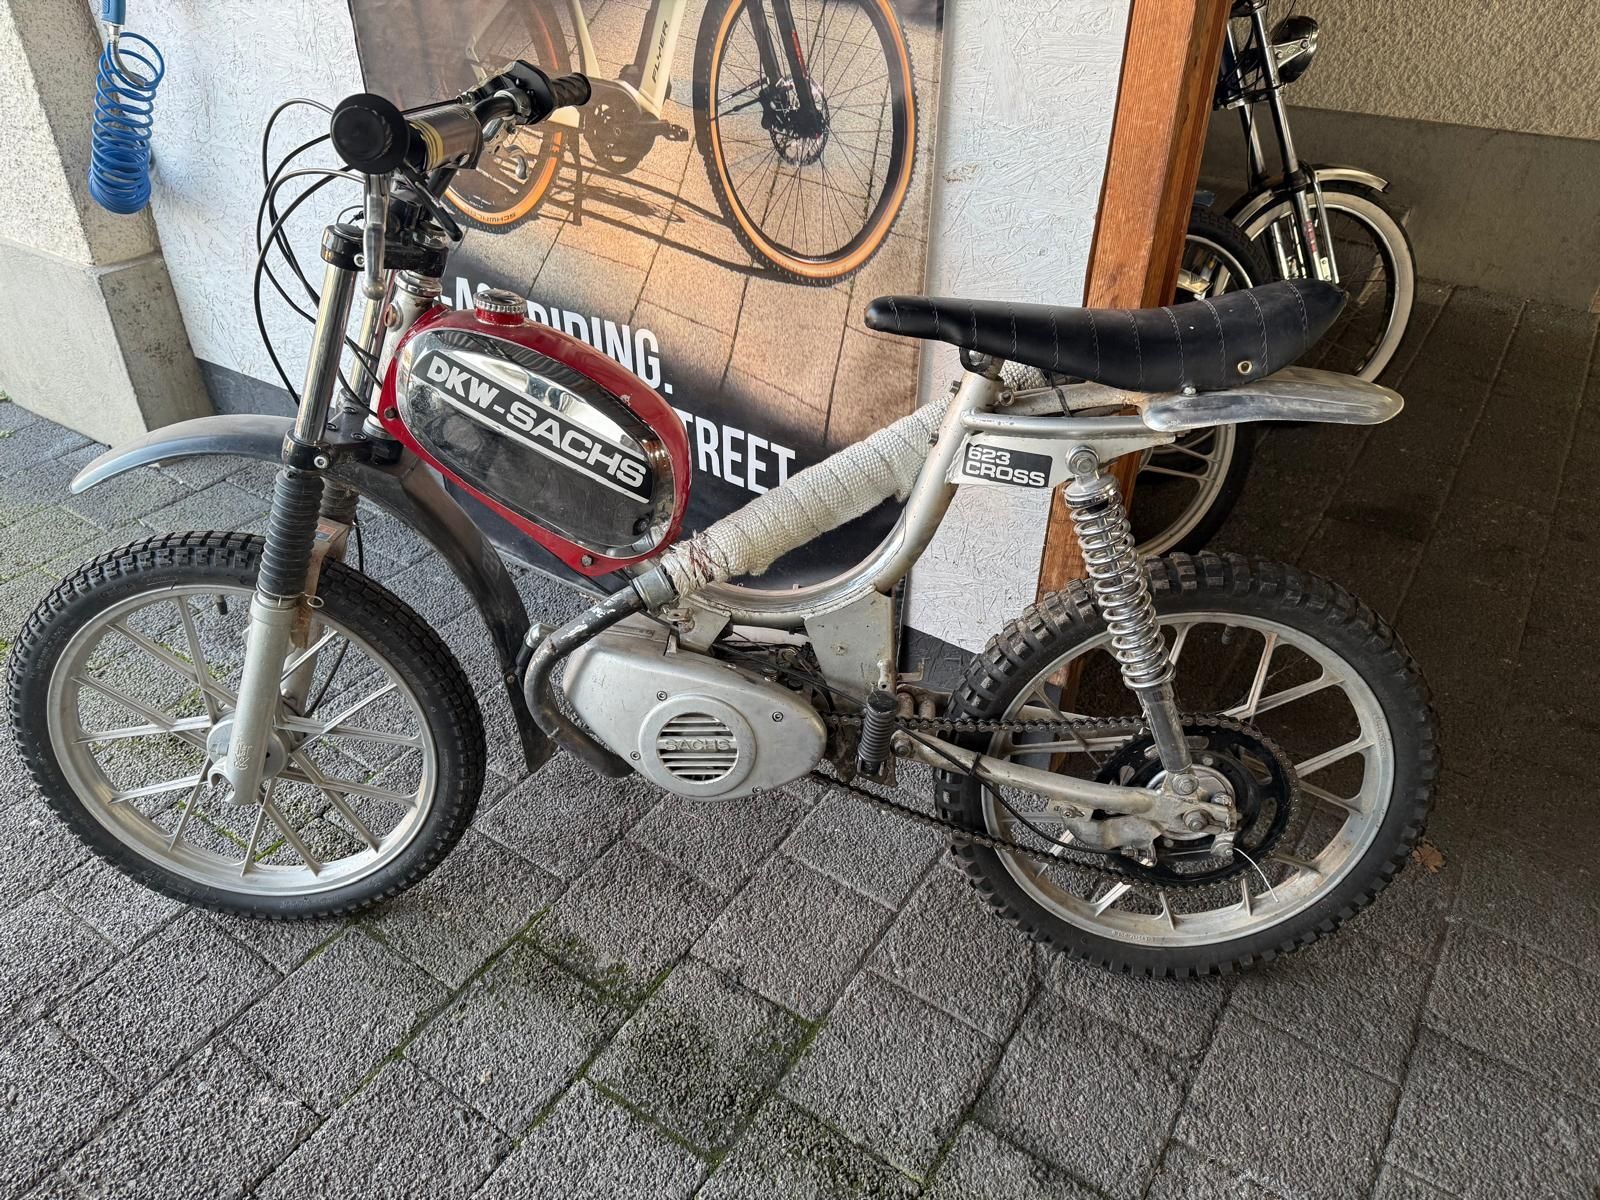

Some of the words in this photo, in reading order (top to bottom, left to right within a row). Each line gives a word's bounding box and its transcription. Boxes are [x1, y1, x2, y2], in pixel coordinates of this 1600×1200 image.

[651, 20, 668, 84] FLYER
[425, 355, 647, 488] DKW-SACHS
[967, 446, 1010, 465] 623
[965, 460, 1045, 487] CROSS
[664, 739, 731, 751] SACHS
